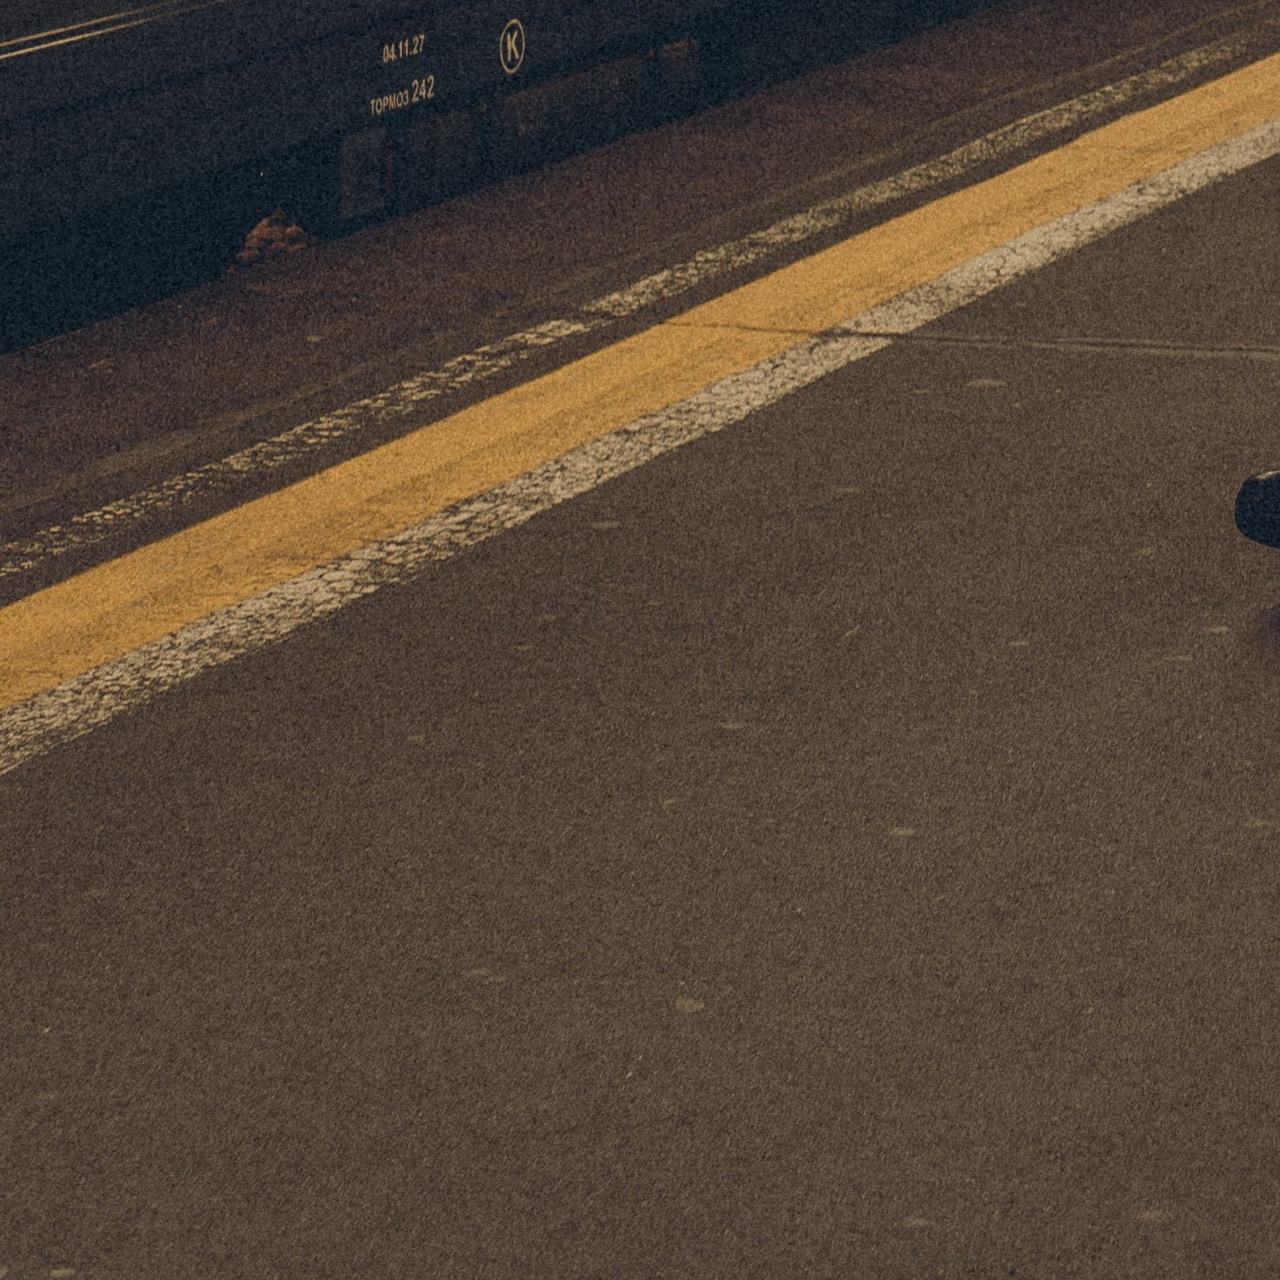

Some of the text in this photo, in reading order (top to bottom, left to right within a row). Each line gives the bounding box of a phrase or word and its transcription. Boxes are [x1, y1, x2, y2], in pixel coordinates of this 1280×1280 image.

[382, 34, 425, 63] 04.11.27
[369, 74, 435, 116] ТОРМОЗ 242
